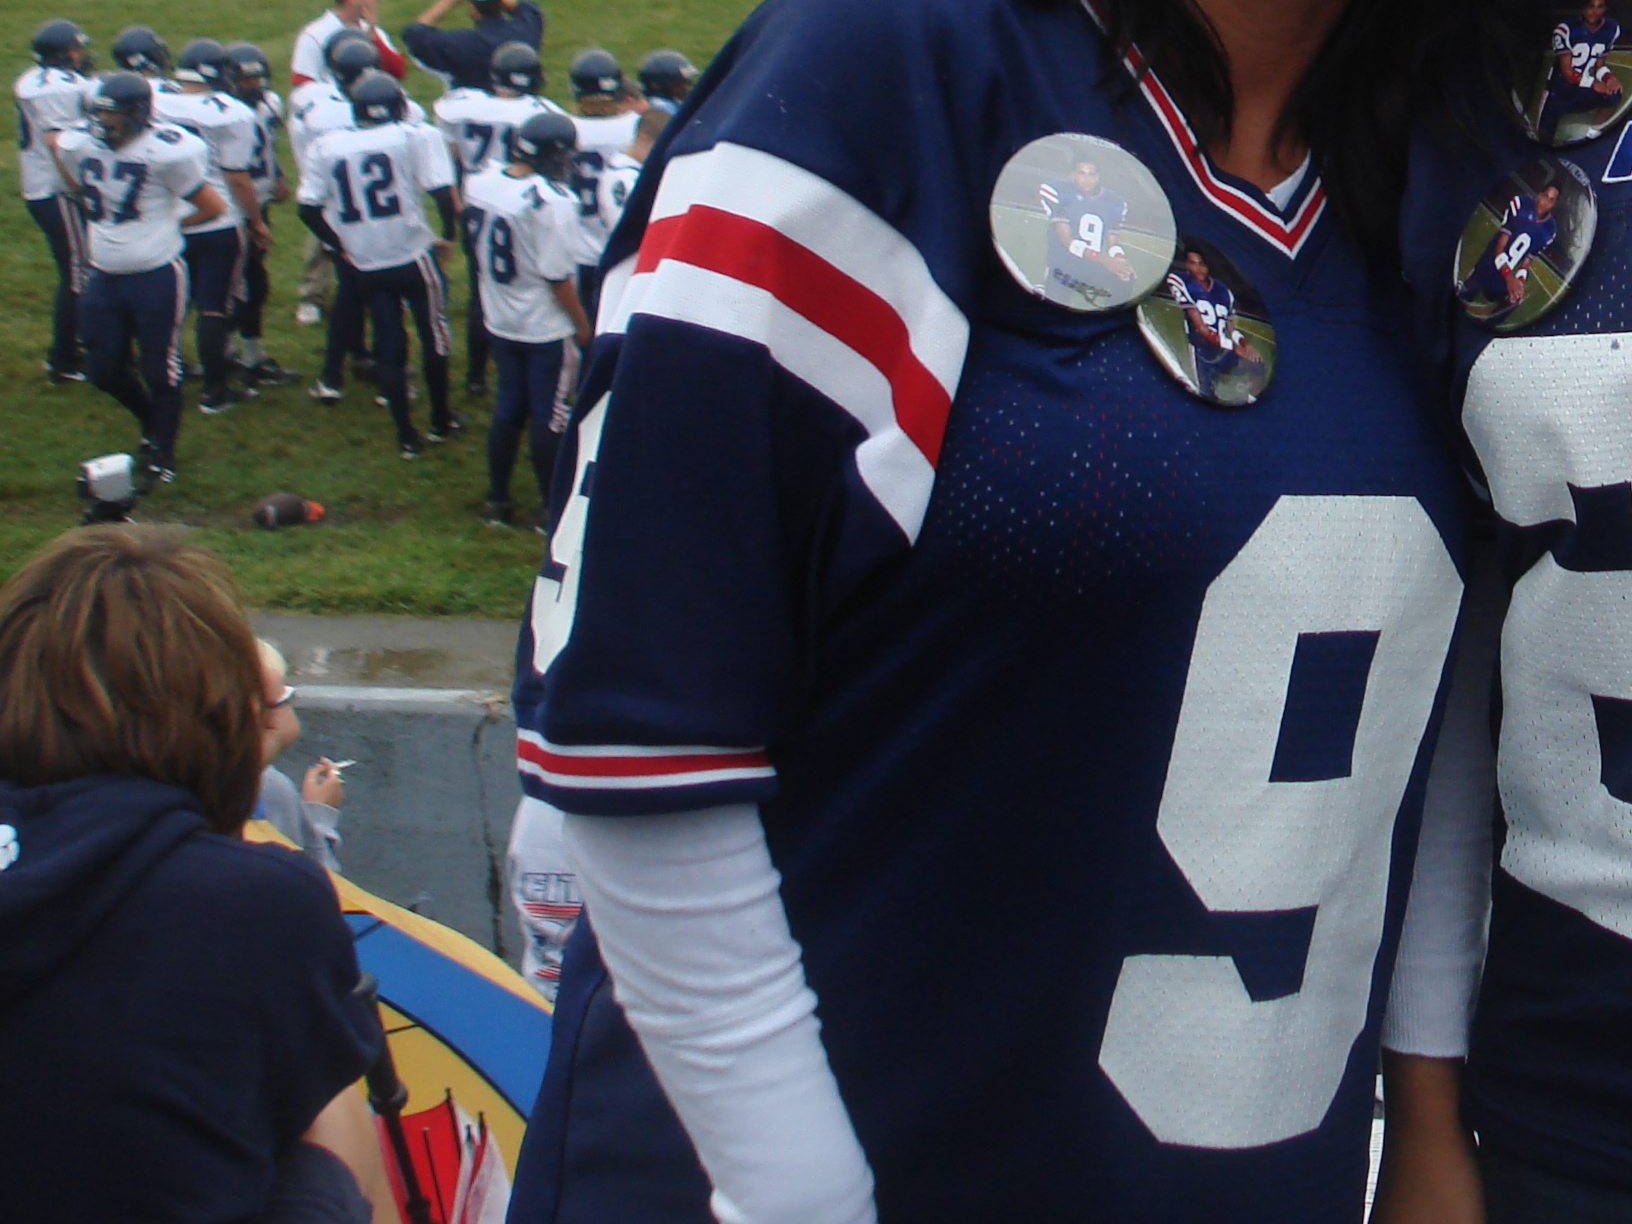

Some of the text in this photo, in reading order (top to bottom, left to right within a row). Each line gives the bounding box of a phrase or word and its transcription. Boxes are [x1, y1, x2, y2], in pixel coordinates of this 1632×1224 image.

[1571, 42, 1606, 88] 22
[332, 152, 402, 223] 12
[1078, 212, 1104, 253] 9
[1507, 232, 1532, 271] 9
[1194, 299, 1233, 351] 22
[1099, 494, 1465, 1149] 9
